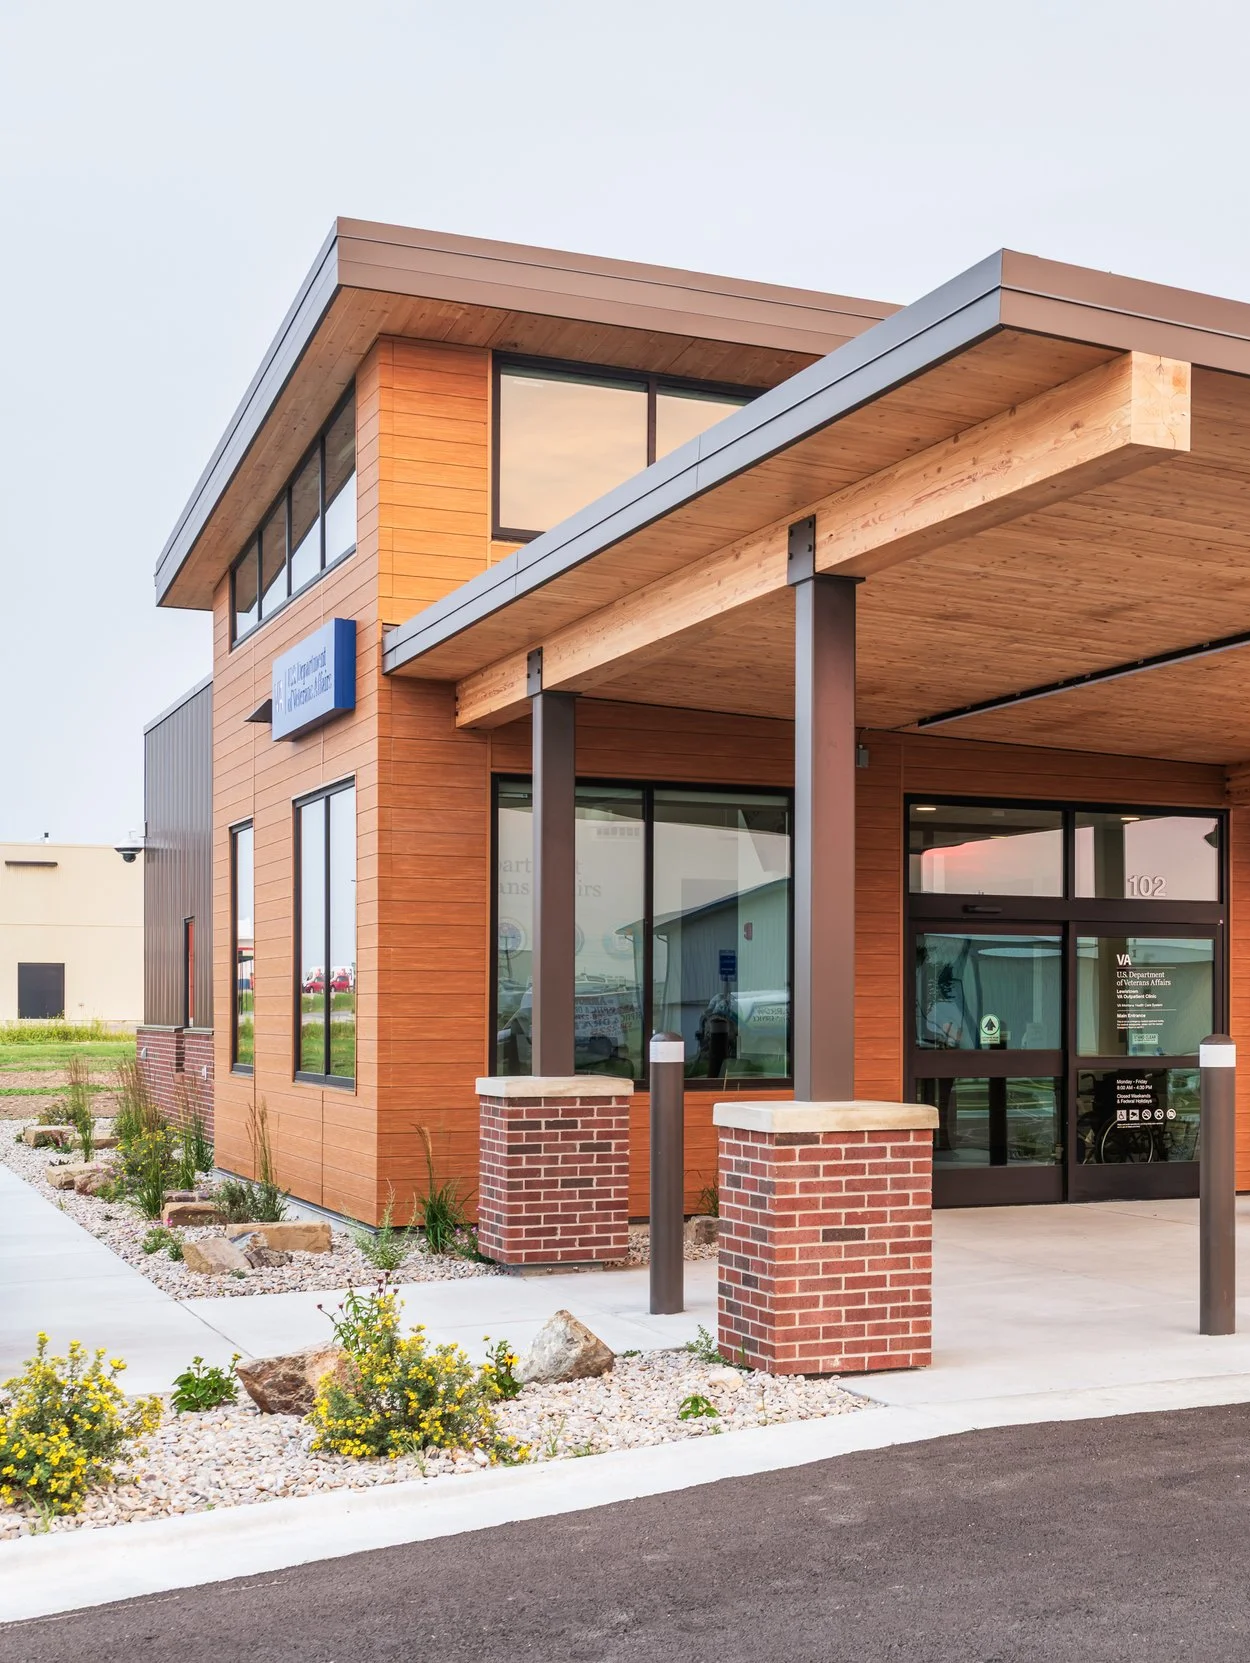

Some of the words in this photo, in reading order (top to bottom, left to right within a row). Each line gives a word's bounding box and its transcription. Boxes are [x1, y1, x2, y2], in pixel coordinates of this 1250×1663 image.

[1128, 875, 1167, 896] 102
[1116, 954, 1132, 966] VA
[1129, 971, 1165, 979] Department
